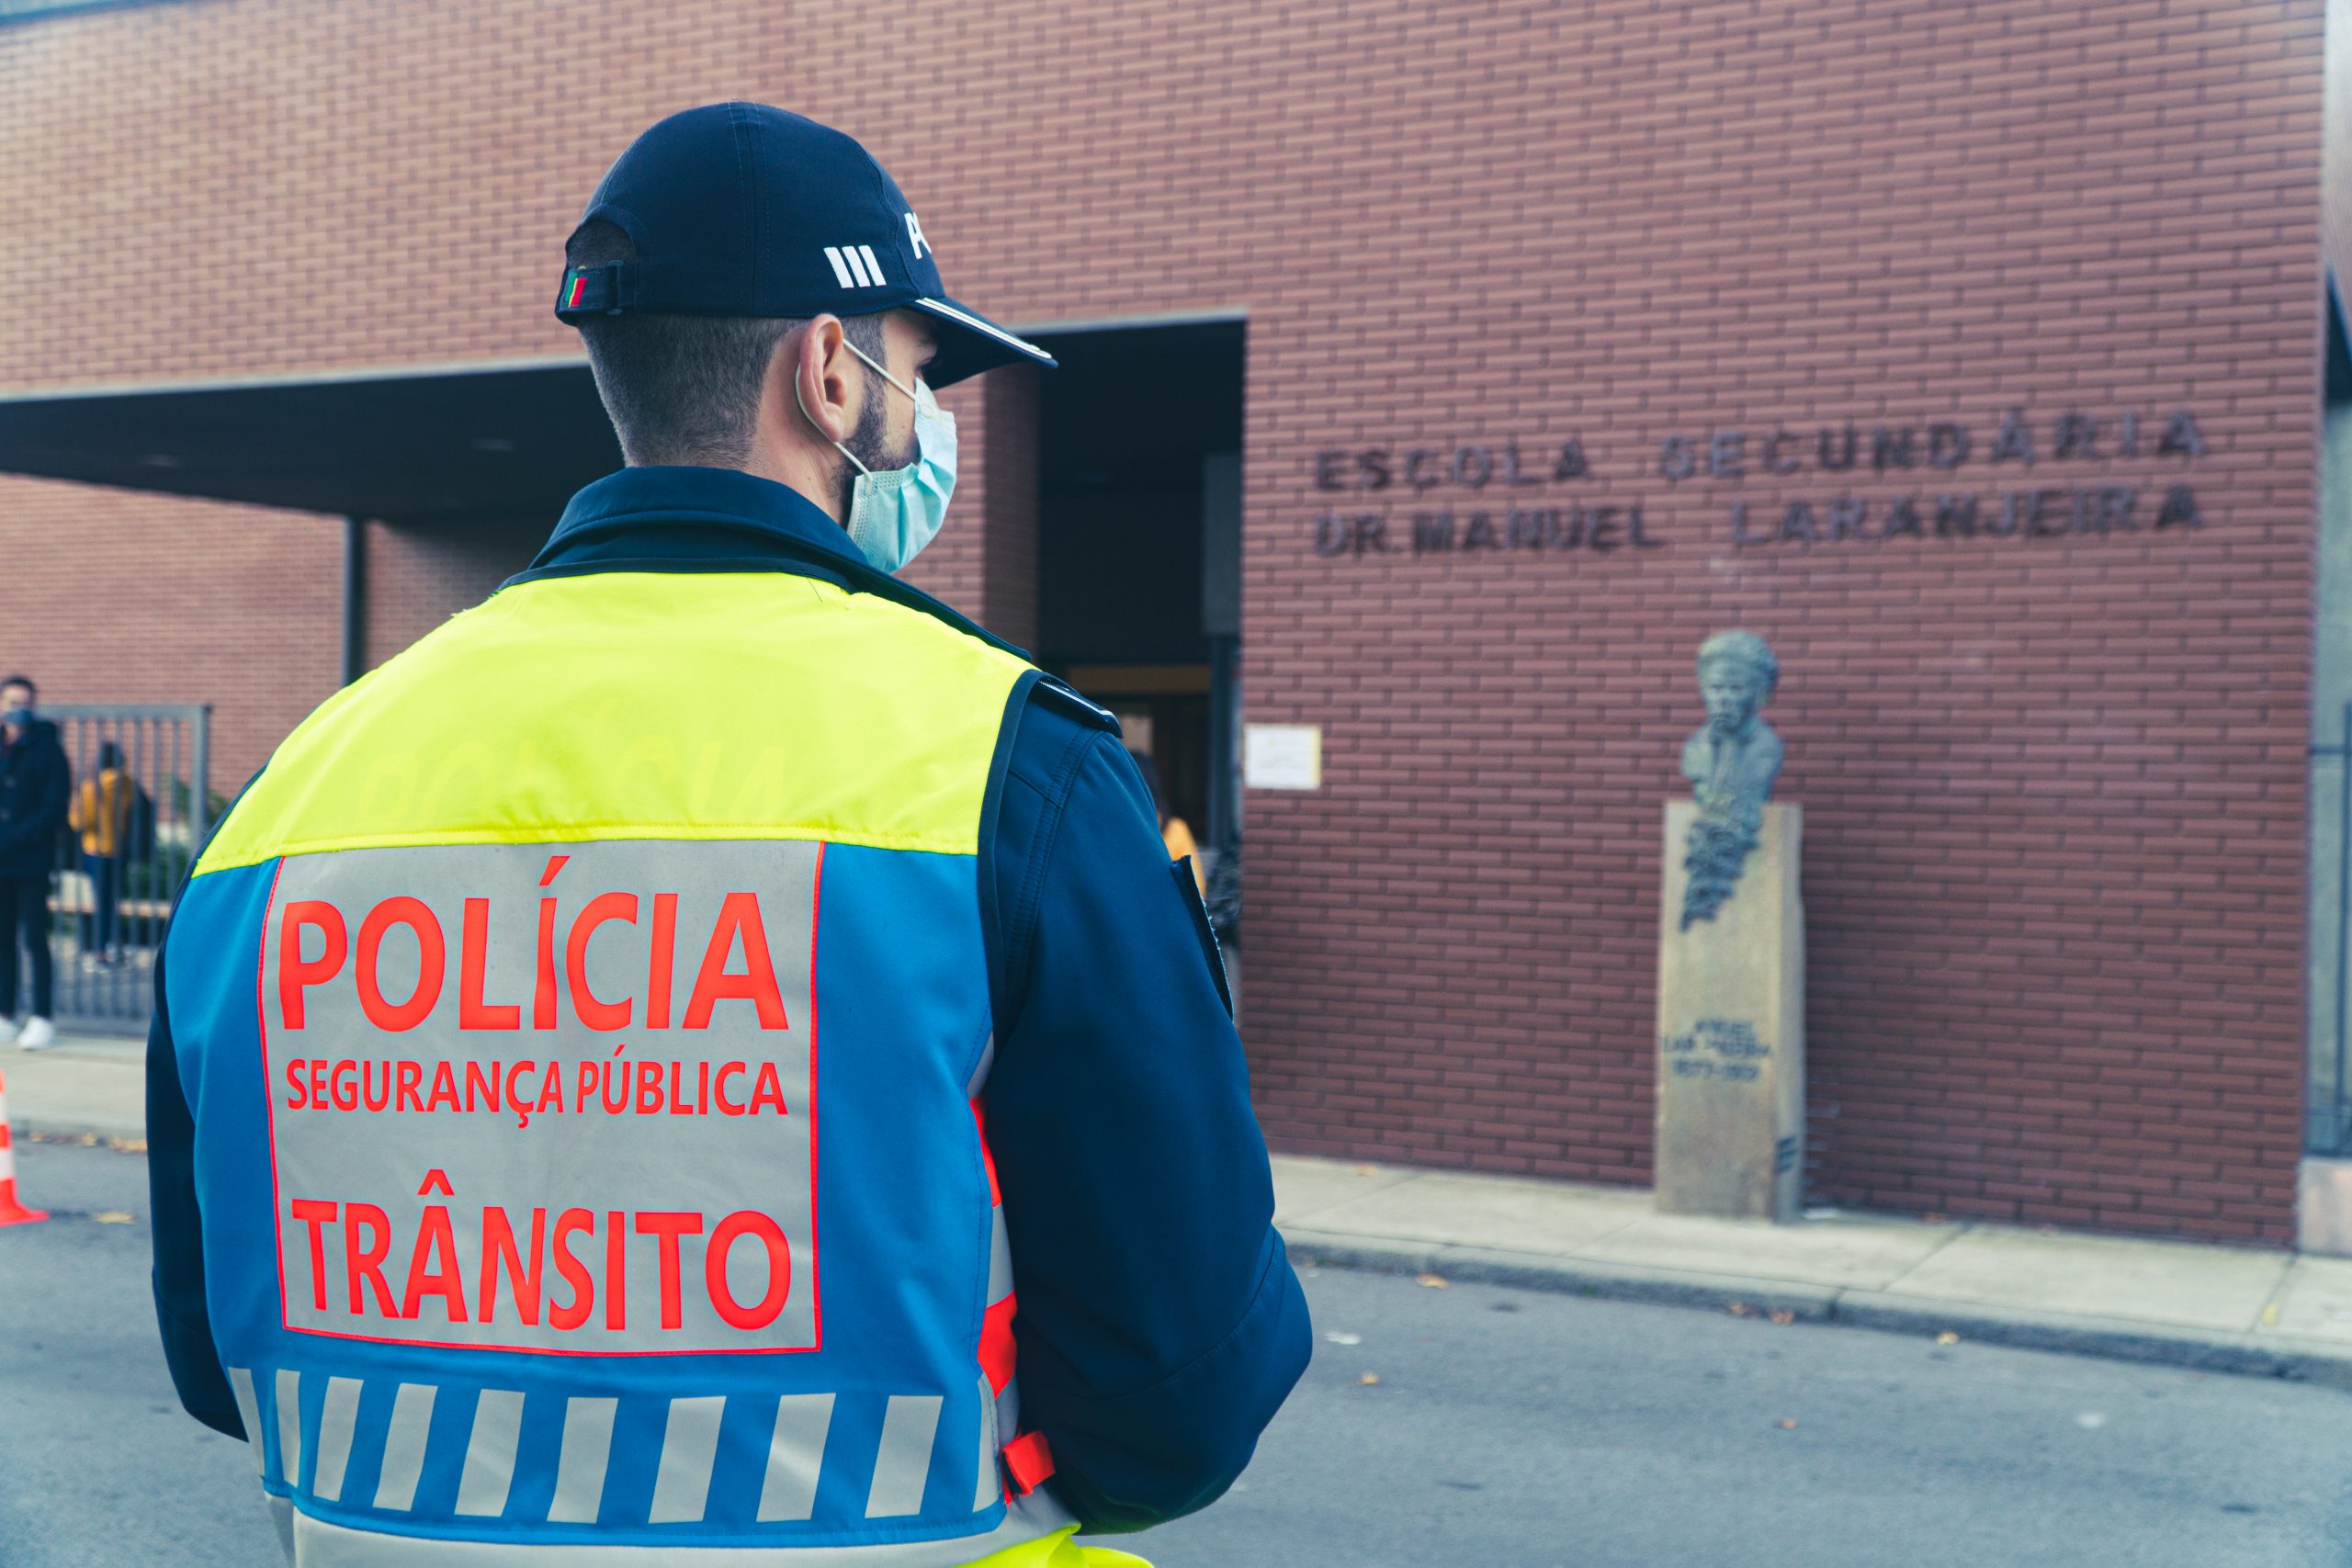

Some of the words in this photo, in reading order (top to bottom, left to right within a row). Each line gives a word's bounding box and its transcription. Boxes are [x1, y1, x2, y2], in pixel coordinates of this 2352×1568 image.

[1316, 440, 1590, 490] ESCOLA
[1731, 484, 2203, 544] LARANJEIRA
[278, 855, 789, 1032] POLÍCIA
[286, 1058, 564, 1129] SEGURANÇA
[576, 1044, 789, 1116] PÚBLICA
[290, 1168, 792, 1331] TRÂNSITO
